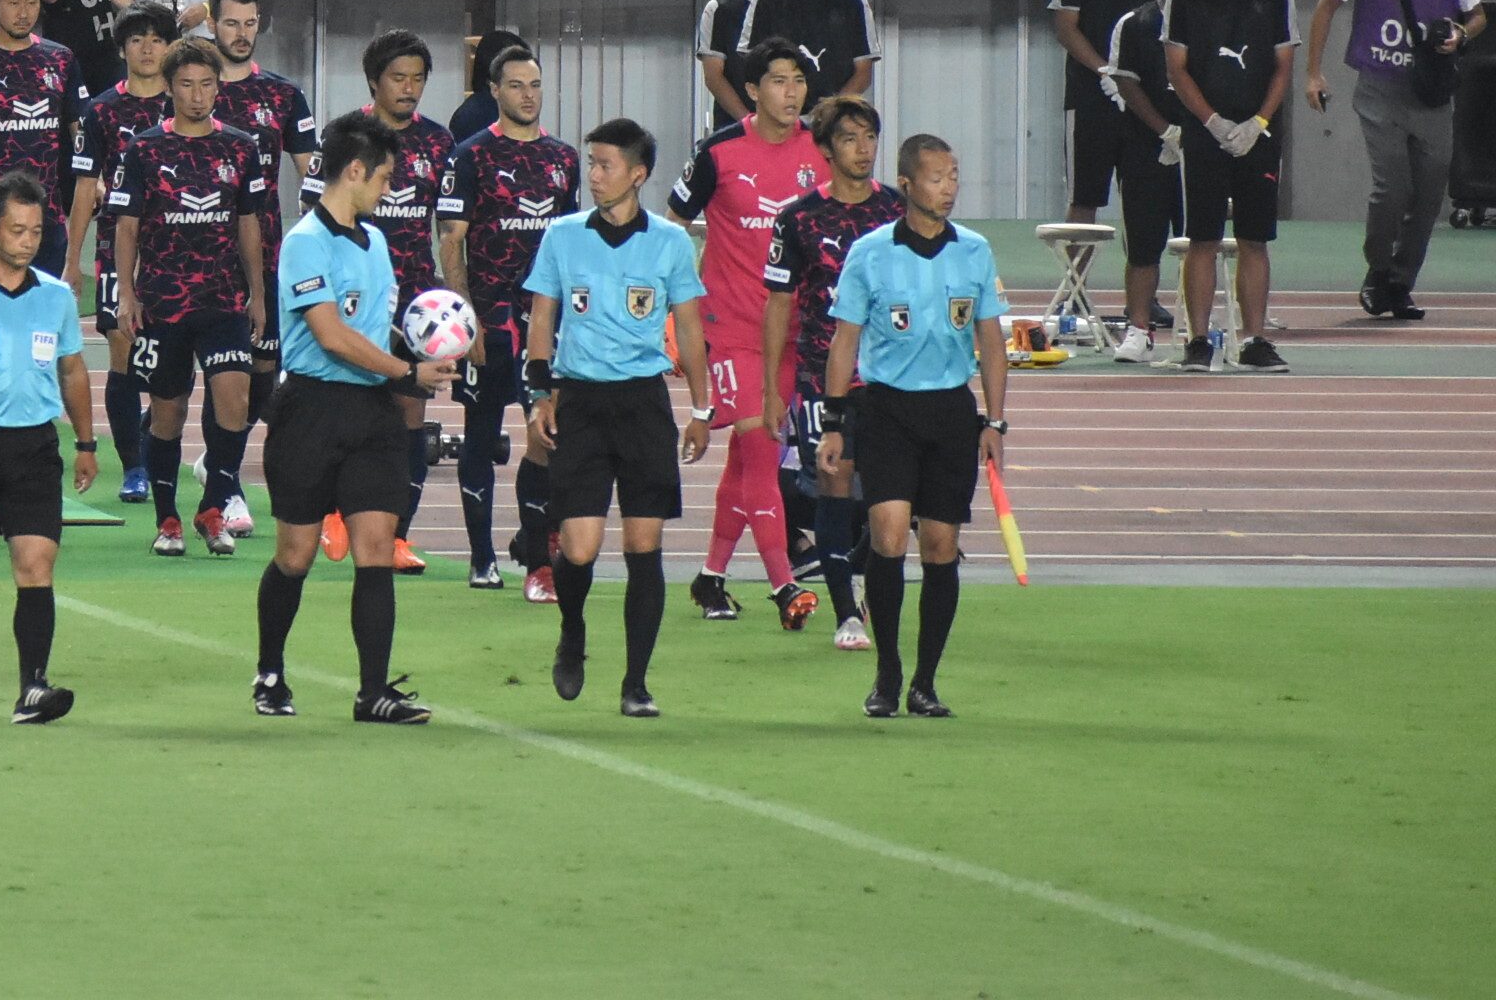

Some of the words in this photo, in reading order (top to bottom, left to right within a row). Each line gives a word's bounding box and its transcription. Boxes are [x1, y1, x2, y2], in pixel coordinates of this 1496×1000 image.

[373, 205, 427, 218] ANMAR
[500, 218, 551, 230] YANM
[740, 216, 775, 229] YAN
[34, 335, 55, 345] FIFA
[133, 337, 158, 368] 25
[713, 360, 738, 394] 21
